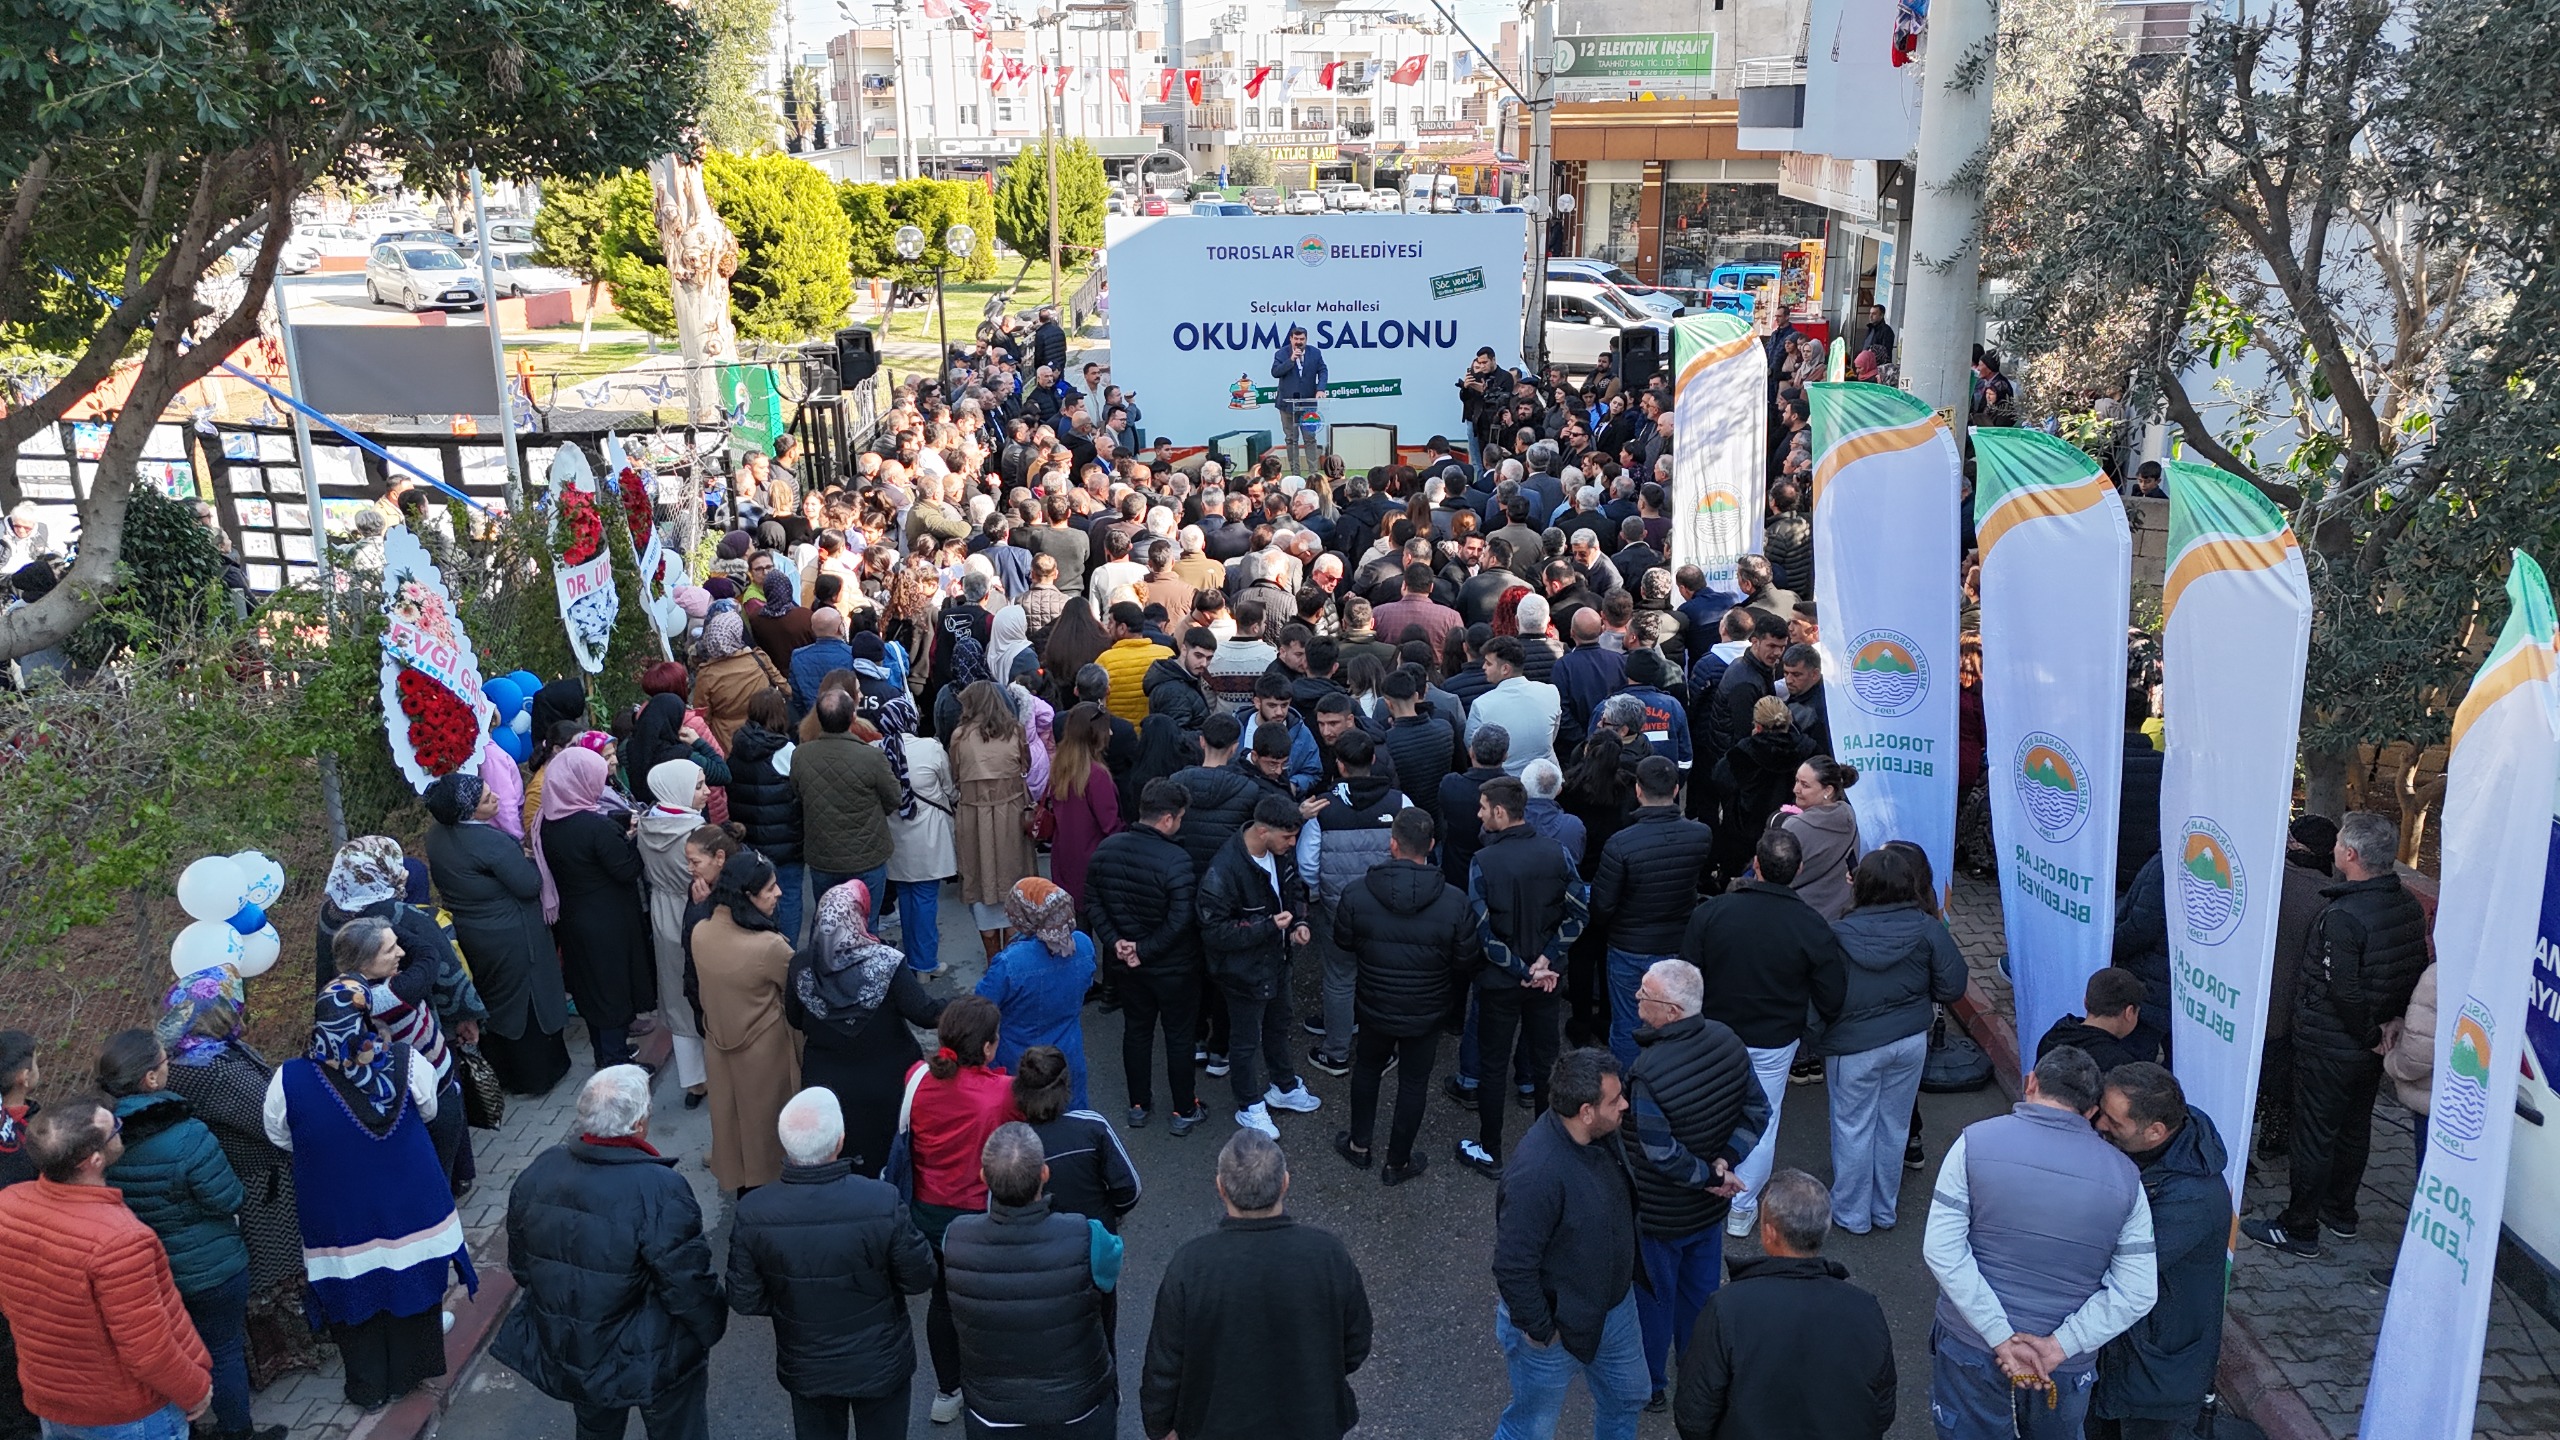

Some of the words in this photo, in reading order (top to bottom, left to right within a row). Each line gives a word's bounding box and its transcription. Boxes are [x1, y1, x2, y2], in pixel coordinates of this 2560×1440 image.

[1580, 42, 1596, 57] 12
[1598, 38, 1660, 56] ELEKTRİK
[1661, 36, 1710, 59] İNŞAAT
[1598, 58, 1628, 68] TAAHHÜT
[1630, 59, 1644, 67] SAN
[1255, 134, 1296, 145] TATLICI
[1300, 132, 1328, 143] RAUF
[1271, 146, 1309, 160] TATLICI
[1312, 145, 1338, 160] RAUF
[1206, 245, 1295, 260] TOROSLAR
[1330, 240, 1424, 259] BELEDİYESİ
[1435, 280, 1450, 290] Söz
[1250, 301, 1311, 316] Selçuklar
[1316, 300, 1380, 313] Mahallesi
[1316, 320, 1458, 350] SALONU
[1332, 387, 1360, 398] gelişen
[566, 573, 591, 600] DR.
[391, 623, 458, 675] EVGİ
[1645, 706, 1670, 722] SLAR
